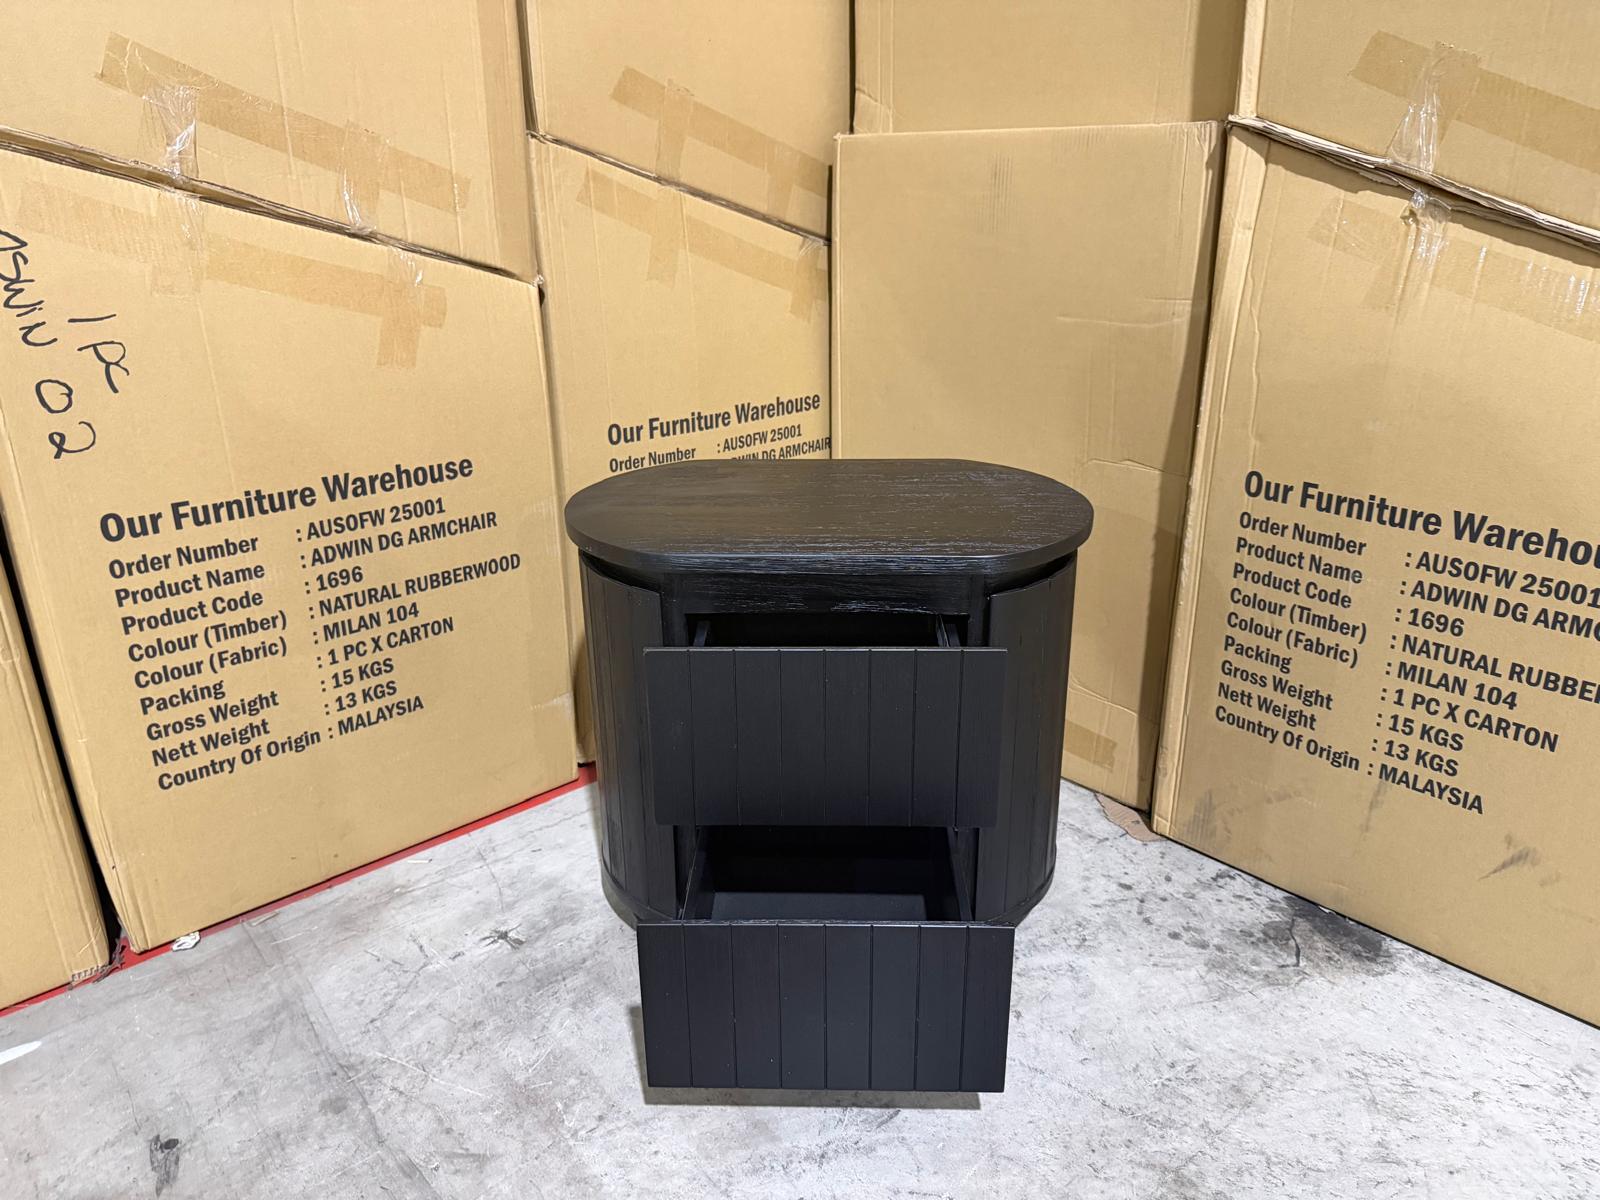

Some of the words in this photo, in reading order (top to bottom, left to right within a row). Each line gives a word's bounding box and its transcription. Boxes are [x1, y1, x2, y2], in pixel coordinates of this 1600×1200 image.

[607, 423, 644, 446] Our
[648, 411, 731, 440] Furniture
[734, 394, 821, 425] Warehouse
[609, 455, 646, 473] Order
[648, 447, 697, 467] Number
[722, 430, 769, 453] AUSOFW
[770, 423, 802, 443] 25001
[778, 436, 832, 460] ARMCHAIR
[99, 511, 163, 543] Our
[170, 486, 317, 531] Furniture
[321, 458, 473, 503] Warehouse
[108, 553, 172, 579] Order
[175, 537, 259, 567] Number
[306, 507, 385, 541] AUSOFW
[389, 497, 446, 524] 25001
[1244, 470, 1295, 505] Our
[1299, 481, 1443, 536] Furniture
[114, 573, 203, 608] Product
[205, 564, 265, 589] Name
[311, 536, 374, 567] ADWIN
[377, 530, 404, 552] DG
[407, 511, 498, 545] ARMCHAIR
[121, 600, 209, 636] Product
[211, 590, 264, 615] Code
[315, 565, 364, 592] 1696
[1232, 561, 1302, 596] Product
[1304, 581, 1352, 609] Code
[1407, 607, 1465, 637] 1696
[1235, 536, 1305, 571] Product
[1308, 553, 1363, 585] Name
[1409, 579, 1489, 614] ADWIN
[1493, 597, 1529, 624] DG
[1239, 511, 1289, 538] Order
[1291, 522, 1367, 556] Number
[1415, 551, 1518, 590] AUSOFW
[1519, 573, 1600, 609] 25001
[127, 633, 199, 663] Colour
[203, 609, 287, 649] (Timber)
[318, 582, 403, 617] NATURAL
[404, 553, 521, 596] RUBBERWOOD
[134, 659, 204, 689] Colour
[209, 635, 287, 675] (Fabric)
[322, 611, 382, 643] MILAN
[386, 601, 420, 625] 104
[1229, 587, 1287, 617] Colour
[1289, 603, 1367, 645] (Timber)
[1401, 633, 1503, 678] NATURAL
[1507, 661, 1600, 705] RUBBE
[139, 679, 226, 716] Packing
[327, 648, 340, 666] 1
[343, 640, 368, 662] PC
[370, 635, 384, 655] X
[386, 616, 454, 649] CARTON
[146, 713, 207, 741] Gross
[208, 690, 280, 724] Weight
[331, 668, 355, 689] 15
[357, 657, 395, 682] KGS
[1223, 634, 1293, 675] Packing
[1393, 688, 1405, 707] 1
[1410, 692, 1441, 716] PC
[1443, 701, 1461, 724] X
[1463, 708, 1559, 753] CARTON
[1226, 611, 1283, 643] Colour
[1285, 628, 1359, 669] (Fabric)
[1397, 661, 1468, 697] MILAN
[1473, 682, 1518, 711] 104
[151, 739, 199, 767] Nett
[199, 718, 271, 753] Weight
[335, 691, 358, 713] 13
[361, 679, 398, 705] KGS
[157, 756, 237, 791] Country
[240, 744, 263, 765] Of
[266, 730, 321, 758] Origin
[337, 695, 425, 736] MALAYSIA
[1217, 681, 1254, 709] Nett
[1256, 694, 1317, 732] Weight
[1383, 739, 1410, 761] 13
[1414, 748, 1459, 777] KGS
[1220, 659, 1268, 689] Gross
[1271, 674, 1334, 711] Weight
[1388, 713, 1415, 737] 15
[1419, 723, 1465, 752] KGS
[1215, 705, 1280, 745] Country
[1282, 729, 1304, 751] Of
[1305, 738, 1360, 771] Origin
[1378, 763, 1483, 815] MALAYSIA
